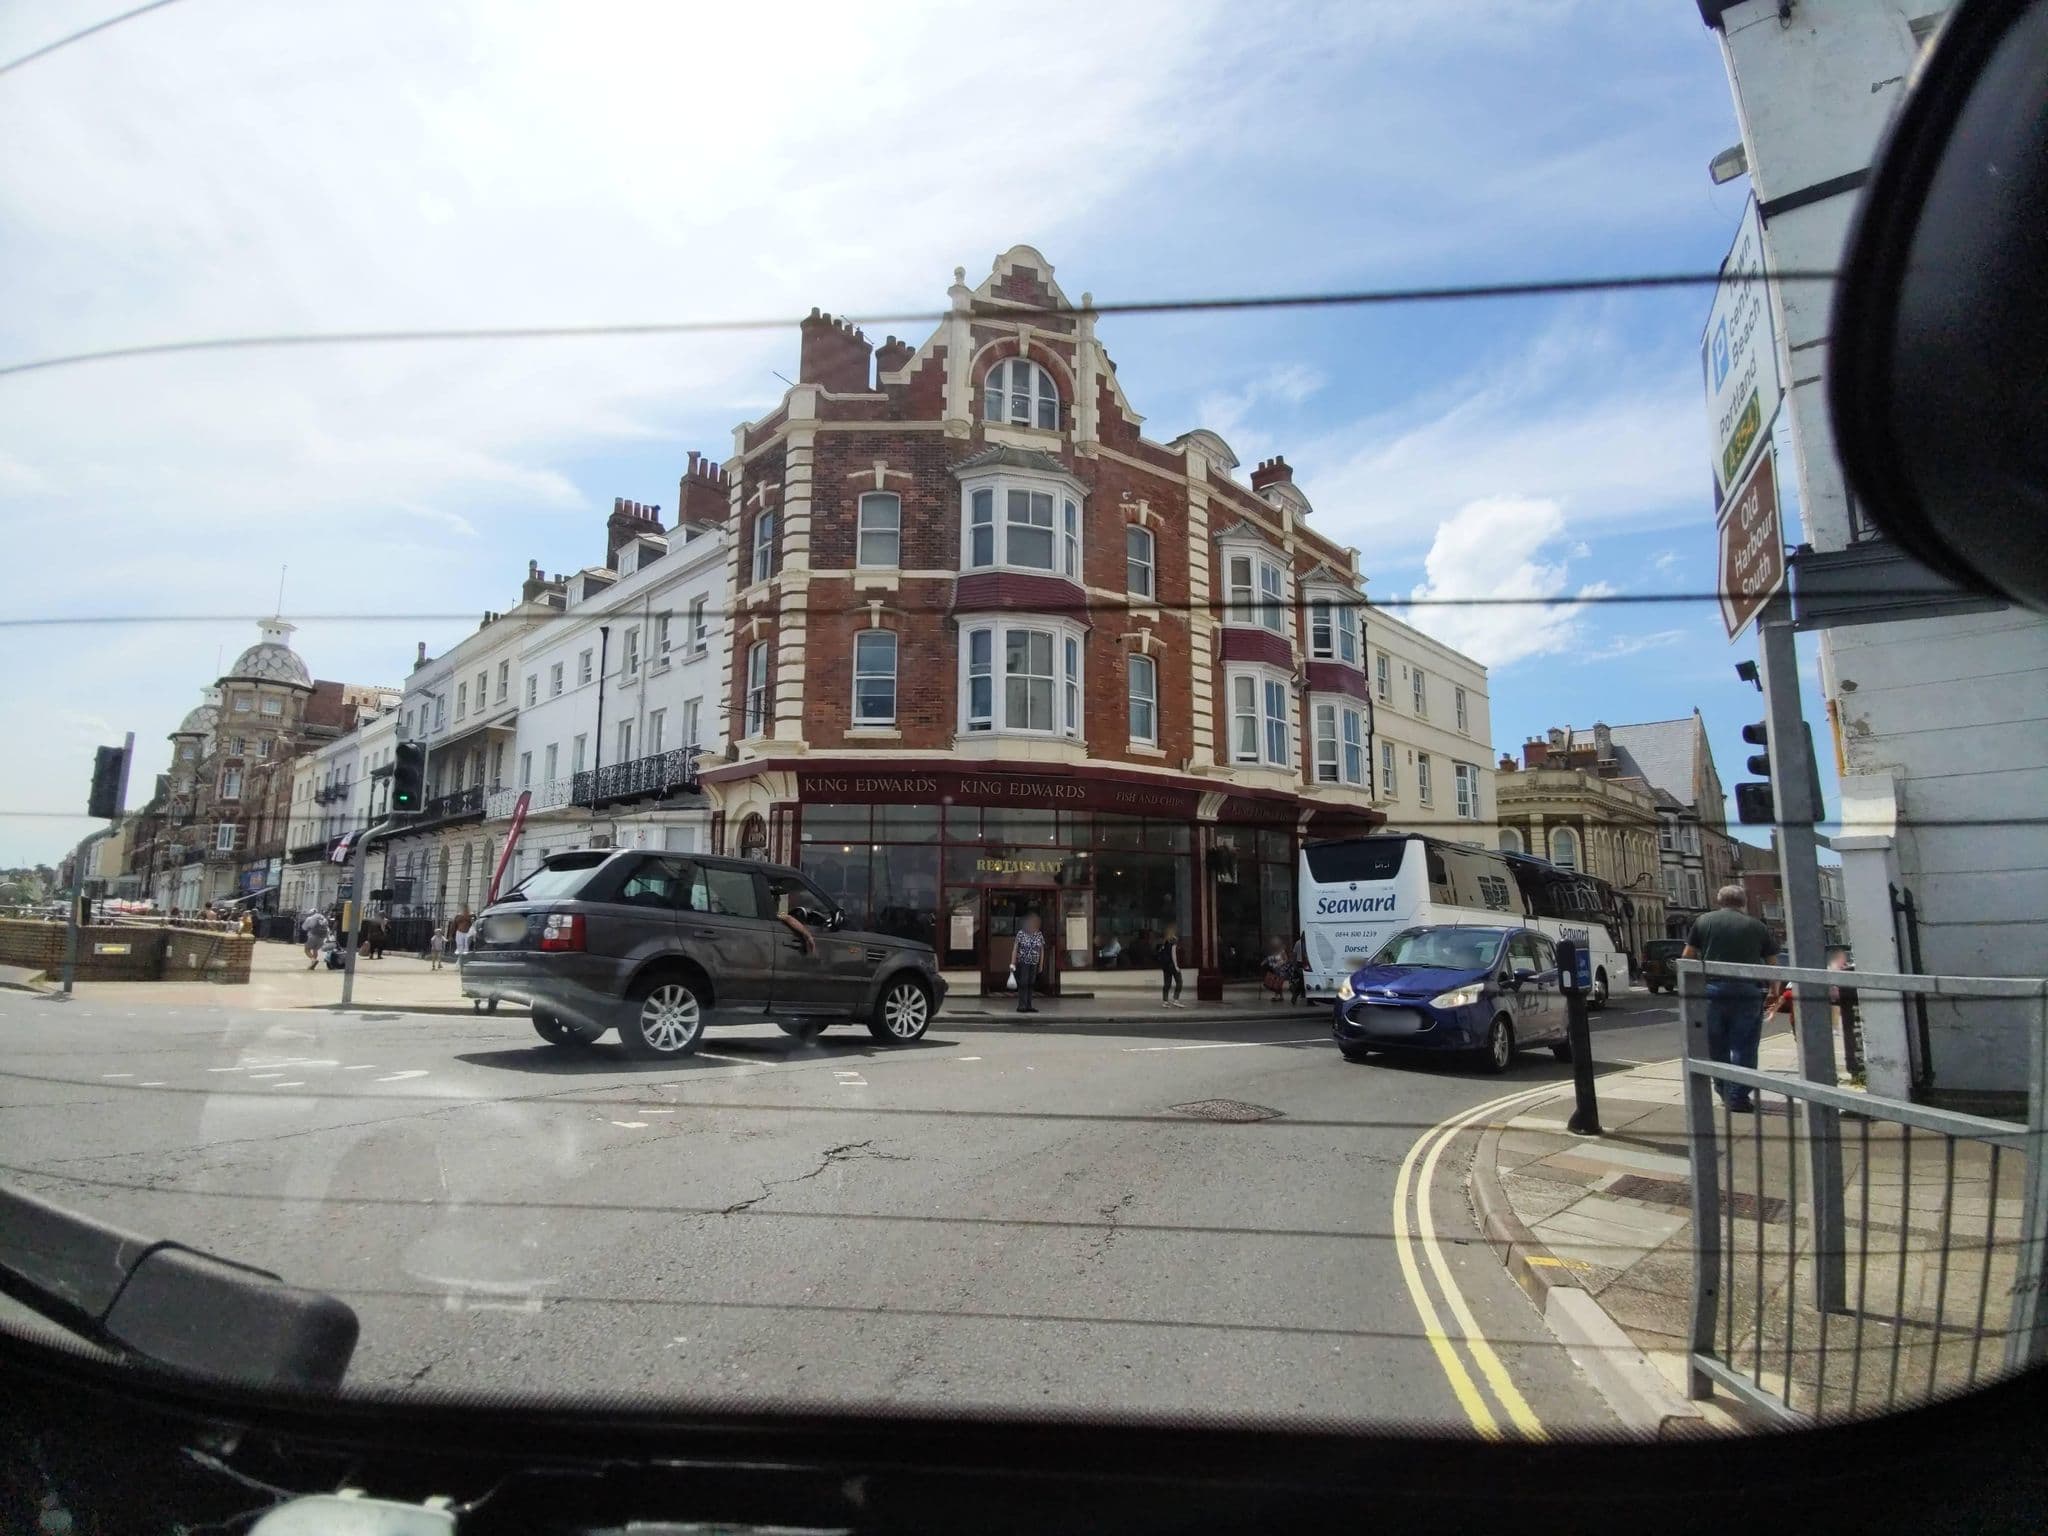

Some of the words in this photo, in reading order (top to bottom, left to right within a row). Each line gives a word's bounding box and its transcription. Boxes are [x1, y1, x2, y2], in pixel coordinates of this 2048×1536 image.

[1728, 234, 1751, 297] Town
[1732, 296, 1761, 369] Beach
[1719, 347, 1758, 444] Portland
[1740, 486, 1759, 531] Old
[1734, 509, 1774, 578] Harbour
[1742, 552, 1772, 606] South
[805, 778, 848, 792] KING
[855, 778, 938, 792] EDWARDS
[960, 780, 1002, 795] KING
[1009, 782, 1087, 799] EDWARDS
[1115, 791, 1136, 803] FISH
[1138, 793, 1158, 805] AND
[976, 858, 1064, 874] RESTAURANT
[1316, 893, 1397, 915] Seaward
[1344, 944, 1369, 953] Dorset
